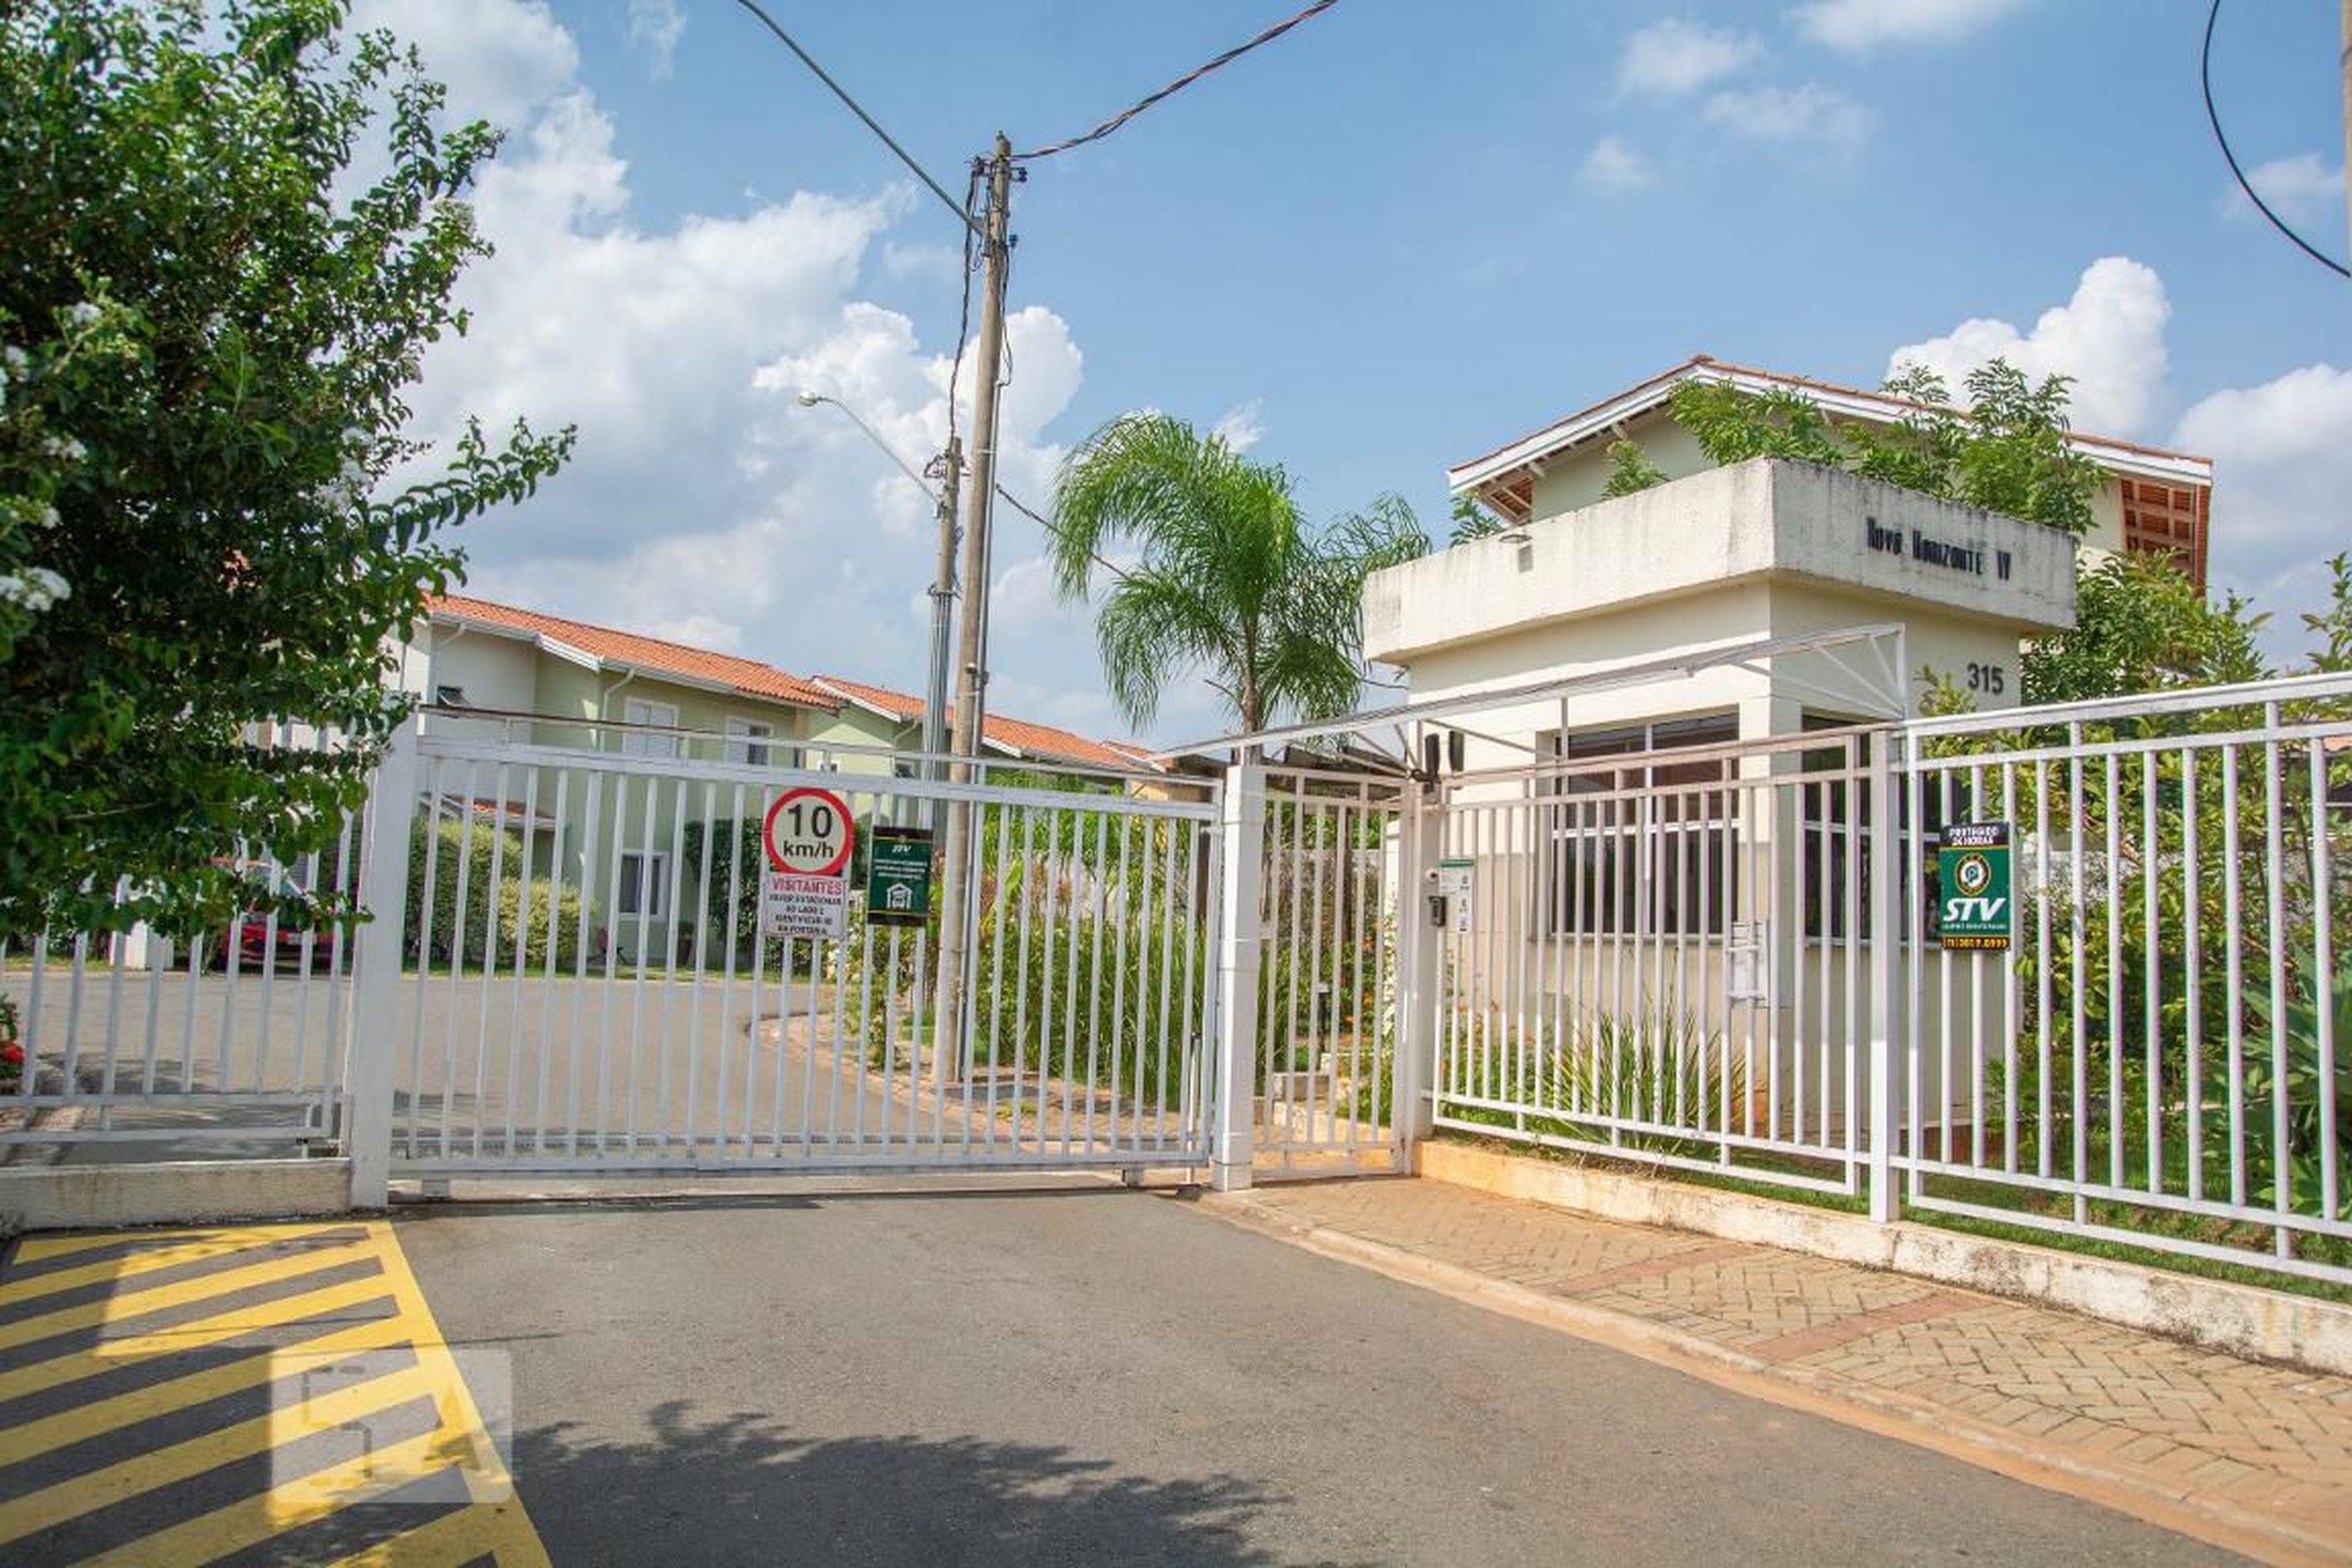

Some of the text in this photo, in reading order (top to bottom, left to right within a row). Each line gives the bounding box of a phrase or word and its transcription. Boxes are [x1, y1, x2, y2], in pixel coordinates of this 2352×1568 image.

[1967, 662, 2004, 695] 315
[787, 804, 833, 838] 10
[783, 840, 834, 859] km/h
[772, 878, 842, 895] VISITANTES
[1943, 897, 2006, 921] STV
